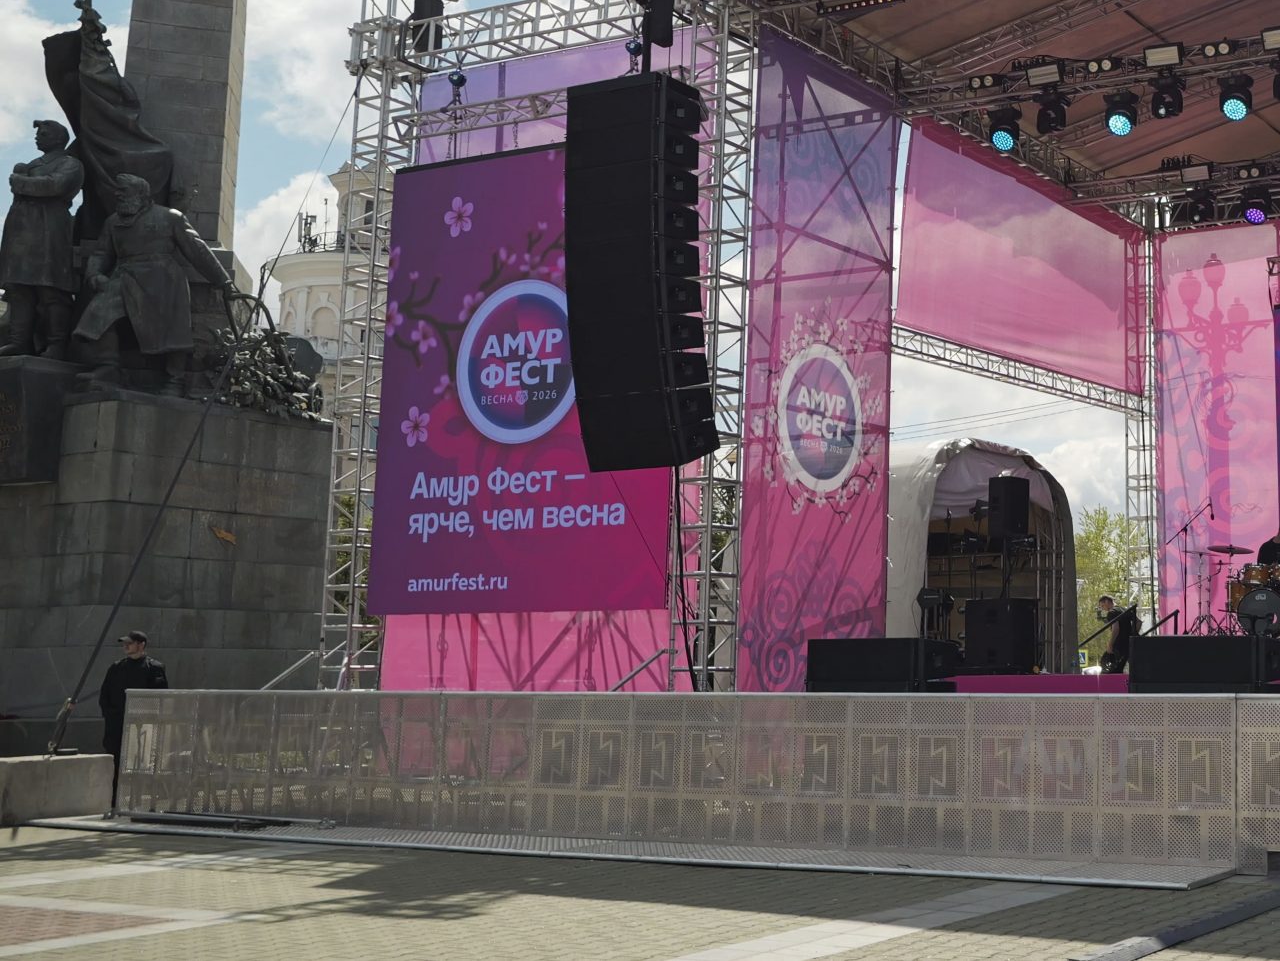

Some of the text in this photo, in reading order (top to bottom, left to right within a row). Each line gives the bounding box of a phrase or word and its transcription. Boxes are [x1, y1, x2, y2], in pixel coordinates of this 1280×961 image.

[480, 328, 563, 359] АМУР
[480, 358, 562, 388] ФЕСТ
[481, 389, 557, 406] ВЕСНА 2026
[796, 385, 847, 417] АМУР
[796, 411, 846, 441] ФЕСТ
[410, 471, 480, 506] Амур
[487, 467, 557, 494] Фест
[408, 502, 625, 543] ярче, чем весна
[408, 572, 508, 592] amurfest.ru
